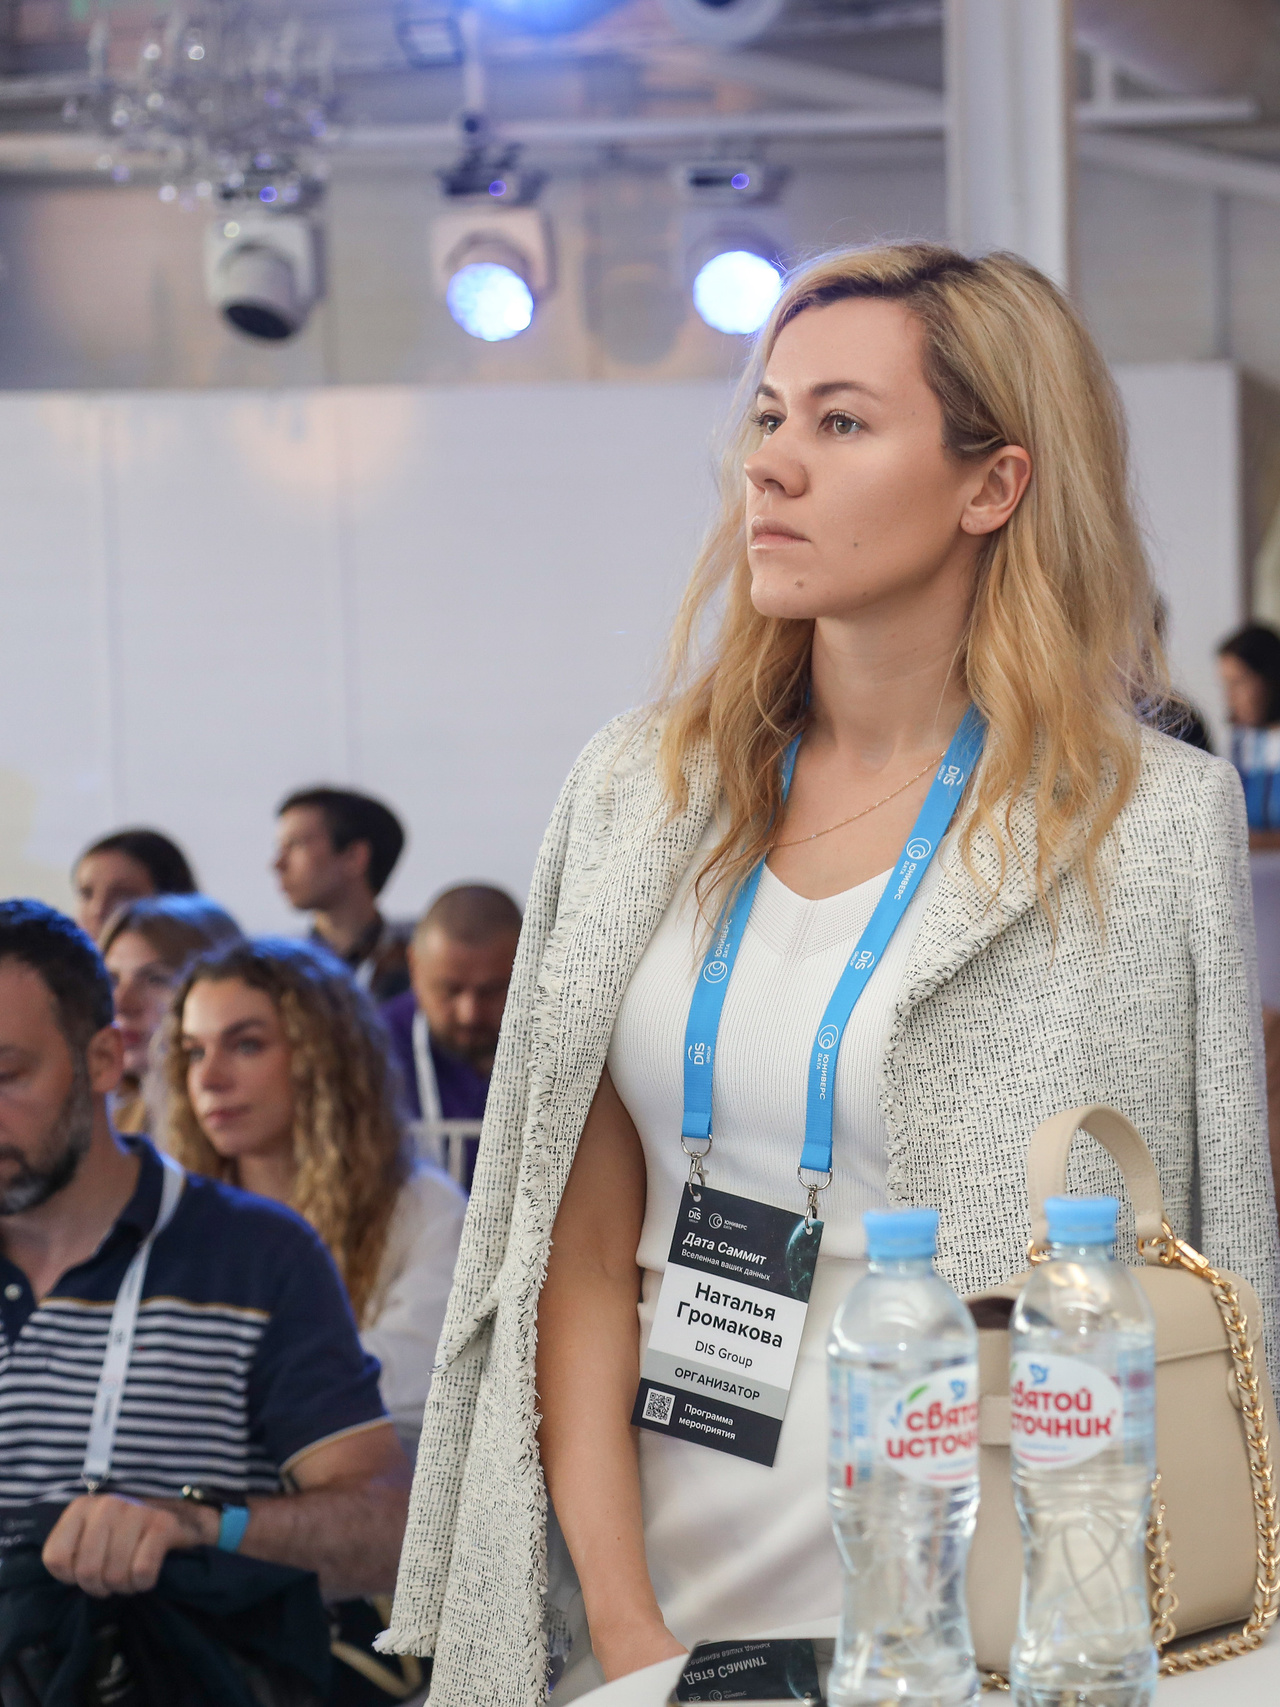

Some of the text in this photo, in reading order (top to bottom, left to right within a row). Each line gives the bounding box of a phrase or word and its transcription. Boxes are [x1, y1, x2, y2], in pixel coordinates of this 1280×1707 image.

[943, 764, 961, 786] DIS
[893, 862, 918, 900] ЮНИВЕРС
[855, 950, 872, 970] DIS
[694, 1042, 705, 1065] DIS
[819, 1053, 830, 1101] ЮНИВЕРС
[688, 1209, 702, 1221] DIS
[724, 1219, 748, 1231] ЮНИВЕРС
[682, 1231, 767, 1265] Дата Саммит
[681, 1248, 771, 1281] Вселенная ваших данных
[695, 1282, 776, 1321] Наталья
[677, 1301, 783, 1348] Громакова
[695, 1340, 753, 1368] DIS Group
[674, 1367, 761, 1400] ОРГАНИЗАТОР
[678, 1417, 737, 1440] мероприятия
[684, 1403, 734, 1426] Программа
